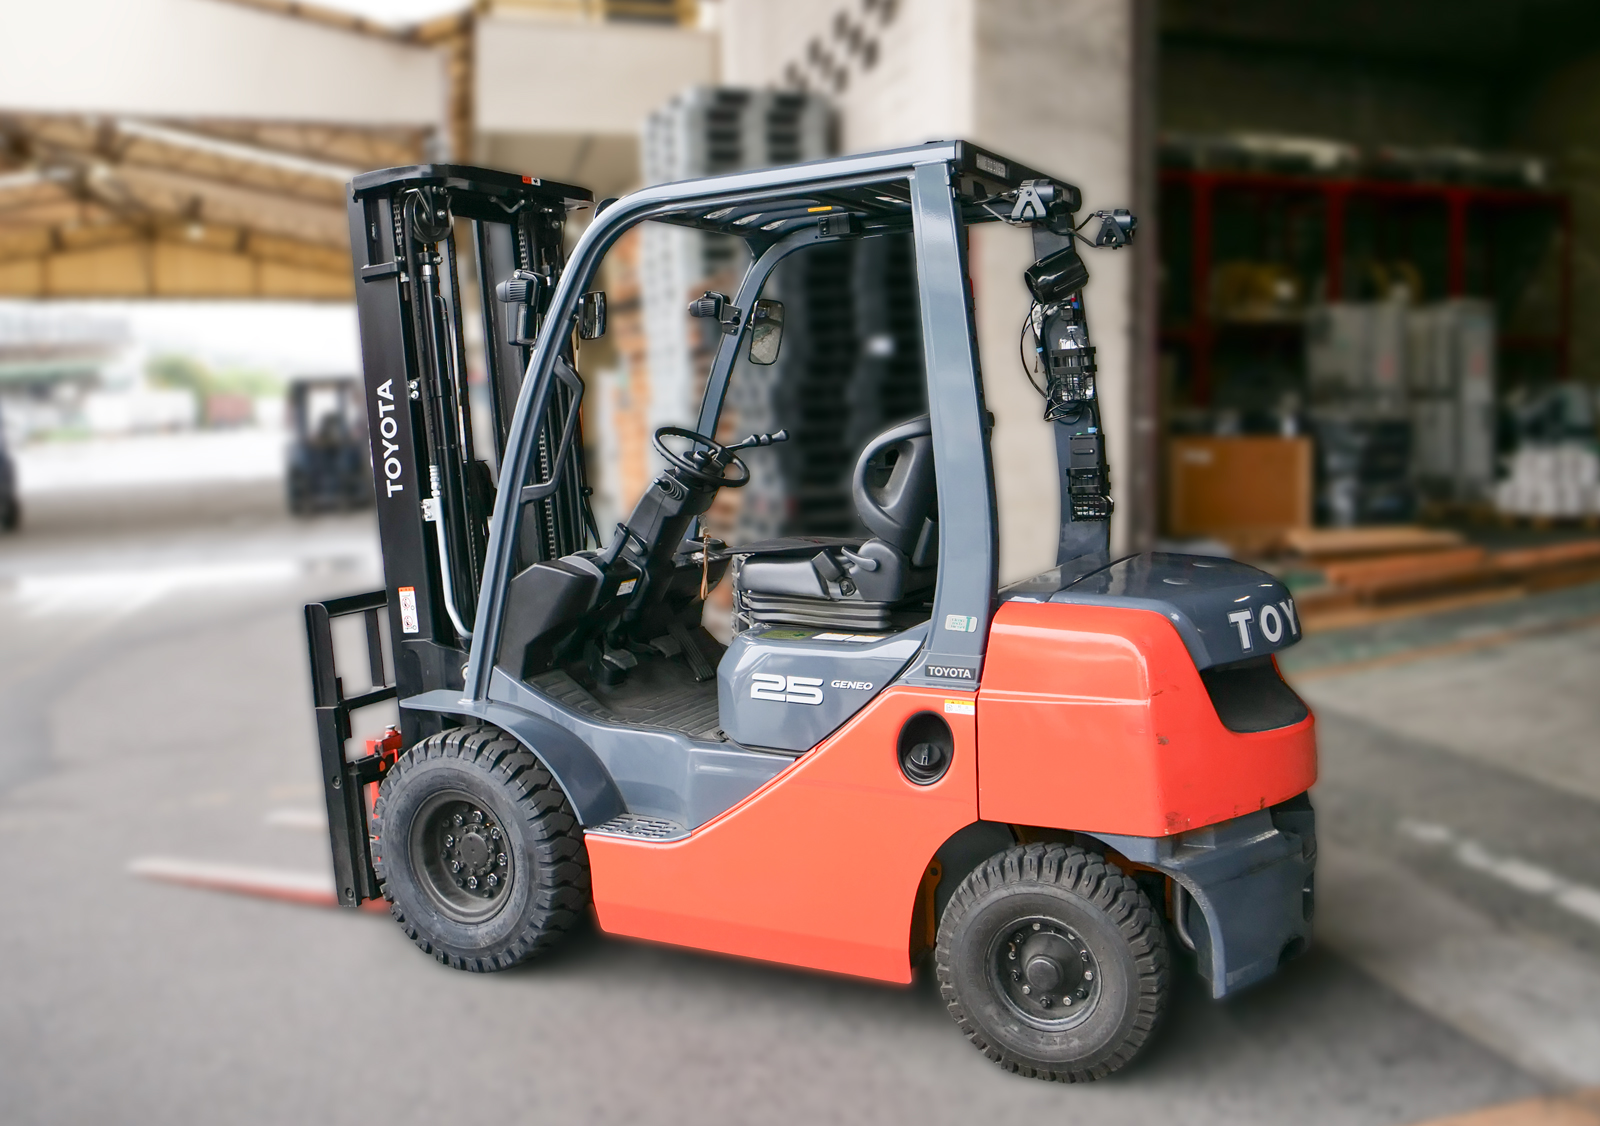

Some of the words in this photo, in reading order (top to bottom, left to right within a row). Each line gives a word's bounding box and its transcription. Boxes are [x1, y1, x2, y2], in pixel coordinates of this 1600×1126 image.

[376, 378, 404, 498] TOYOTA
[1228, 598, 1298, 650] TOY
[750, 672, 824, 706] 25
[830, 679, 875, 691] GENEO
[928, 666, 972, 679] TOYOTA
